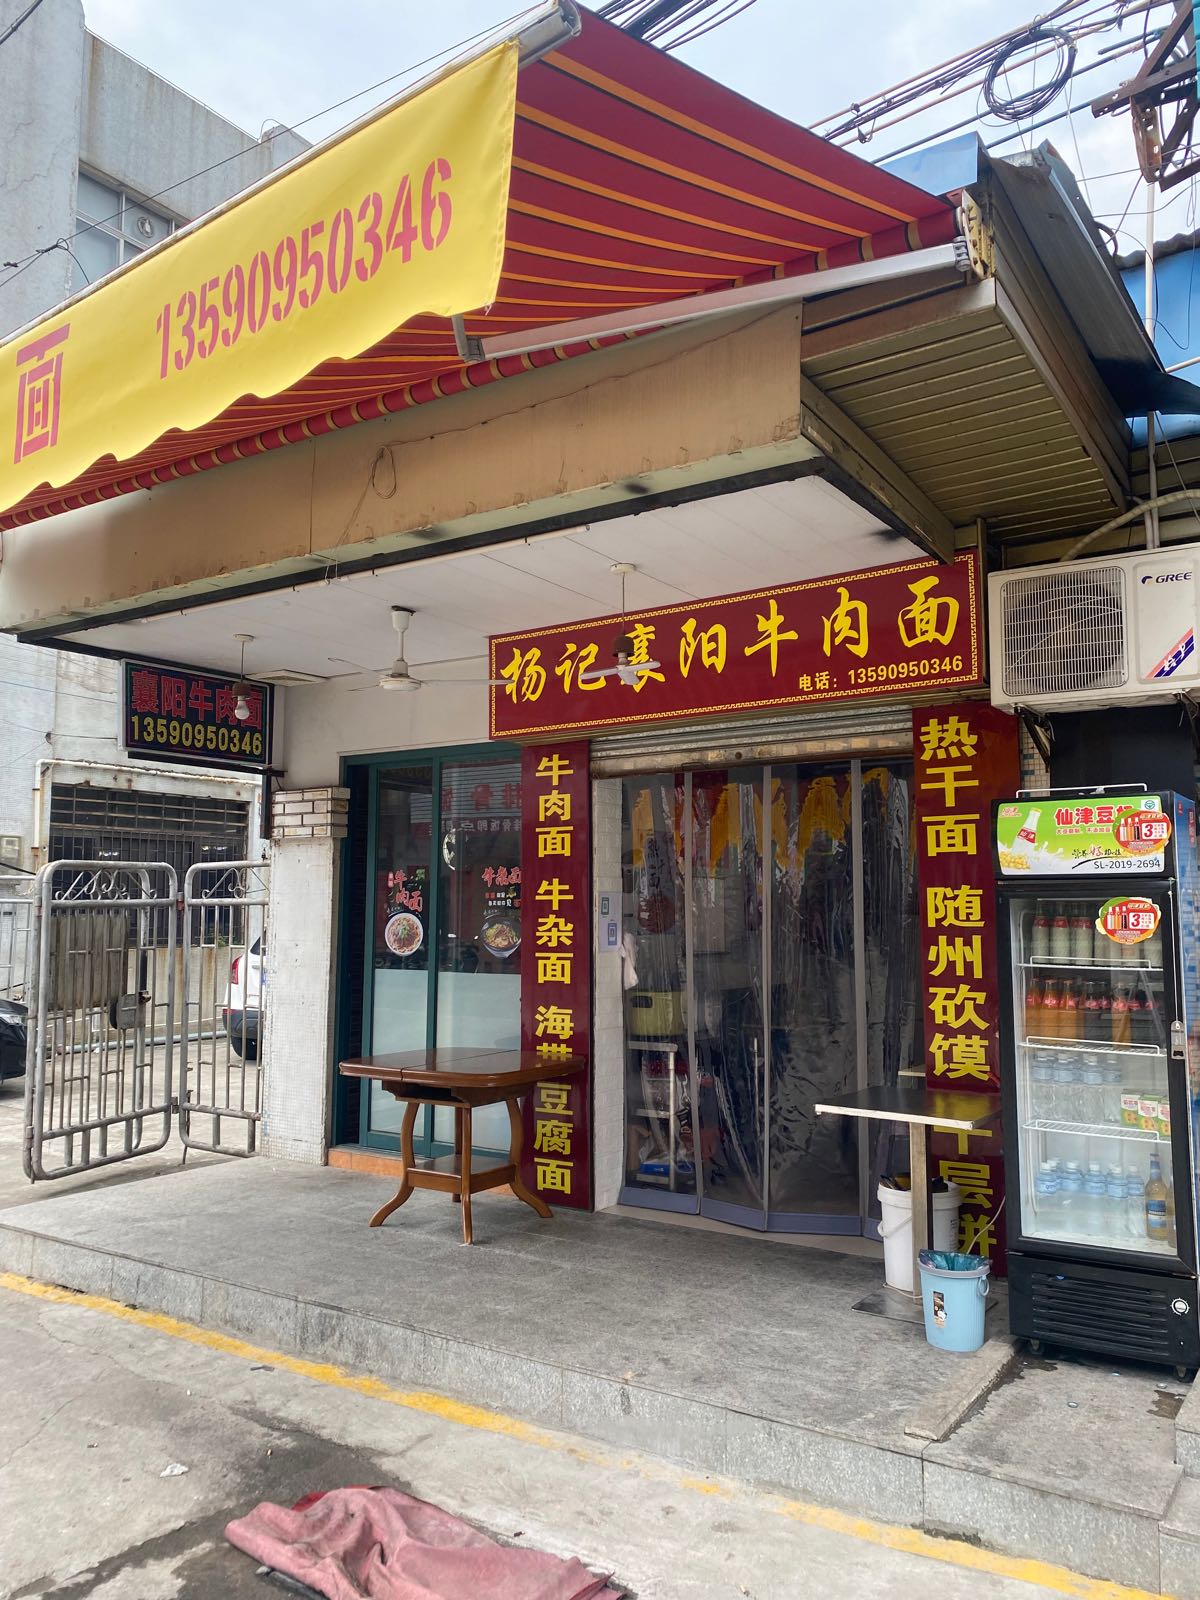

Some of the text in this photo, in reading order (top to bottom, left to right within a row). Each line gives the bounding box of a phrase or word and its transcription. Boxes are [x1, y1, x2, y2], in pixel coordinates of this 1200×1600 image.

[13, 158, 453, 464] 面 13590950346
[1155, 571, 1193, 584] GREE
[501, 575, 961, 706] 杨记襄阳牛肉面
[847, 655, 964, 686] 13590950346
[131, 715, 262, 756] 13590950346
[919, 715, 980, 857] 热干面
[535, 754, 574, 858] 牛肉面
[1093, 859, 1161, 870] SL-2019-2694
[535, 878, 574, 985] 牛杂面
